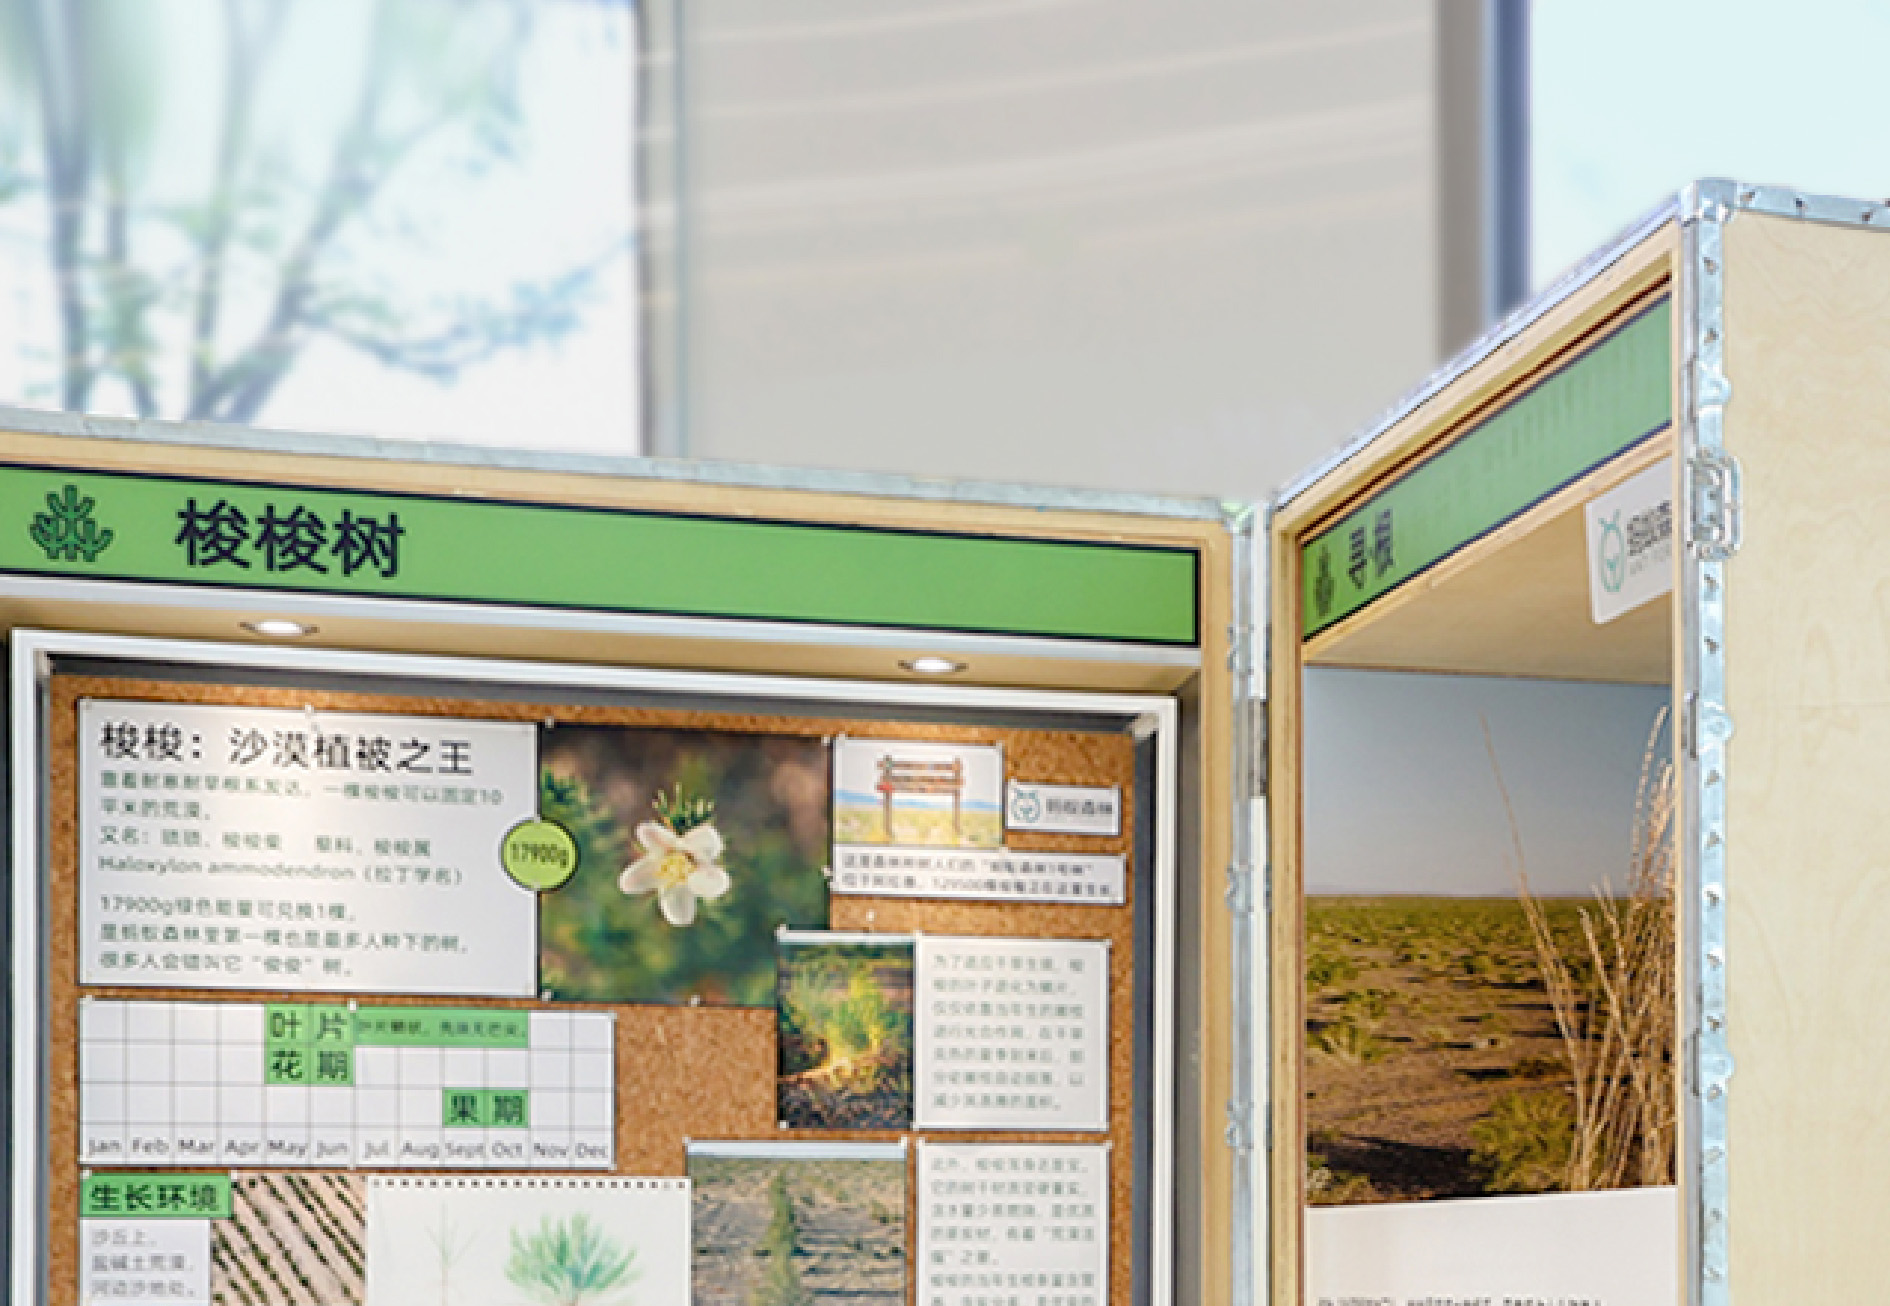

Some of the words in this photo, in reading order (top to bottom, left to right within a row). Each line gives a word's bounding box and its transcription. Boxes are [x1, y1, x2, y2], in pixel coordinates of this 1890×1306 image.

[175, 498, 405, 578] 梭梭树
[99, 719, 474, 776] 梭梭：沙漠植被之王
[511, 841, 571, 870] 17900g
[271, 1049, 348, 1080] 花期
[450, 1094, 524, 1124] 果期
[89, 1137, 122, 1158] Jan
[132, 1137, 169, 1153] Feb
[178, 1139, 215, 1154] Mar
[225, 1139, 260, 1160] Apr
[268, 1139, 307, 1158] May
[316, 1139, 348, 1158] Jun
[364, 1140, 389, 1158] Jul
[402, 1141, 440, 1159] Aug
[444, 1142, 485, 1159] Sept
[492, 1142, 523, 1158] Oct
[534, 1142, 568, 1157] Nov
[575, 1142, 609, 1158] Dec
[89, 1183, 220, 1212] 生长环境
